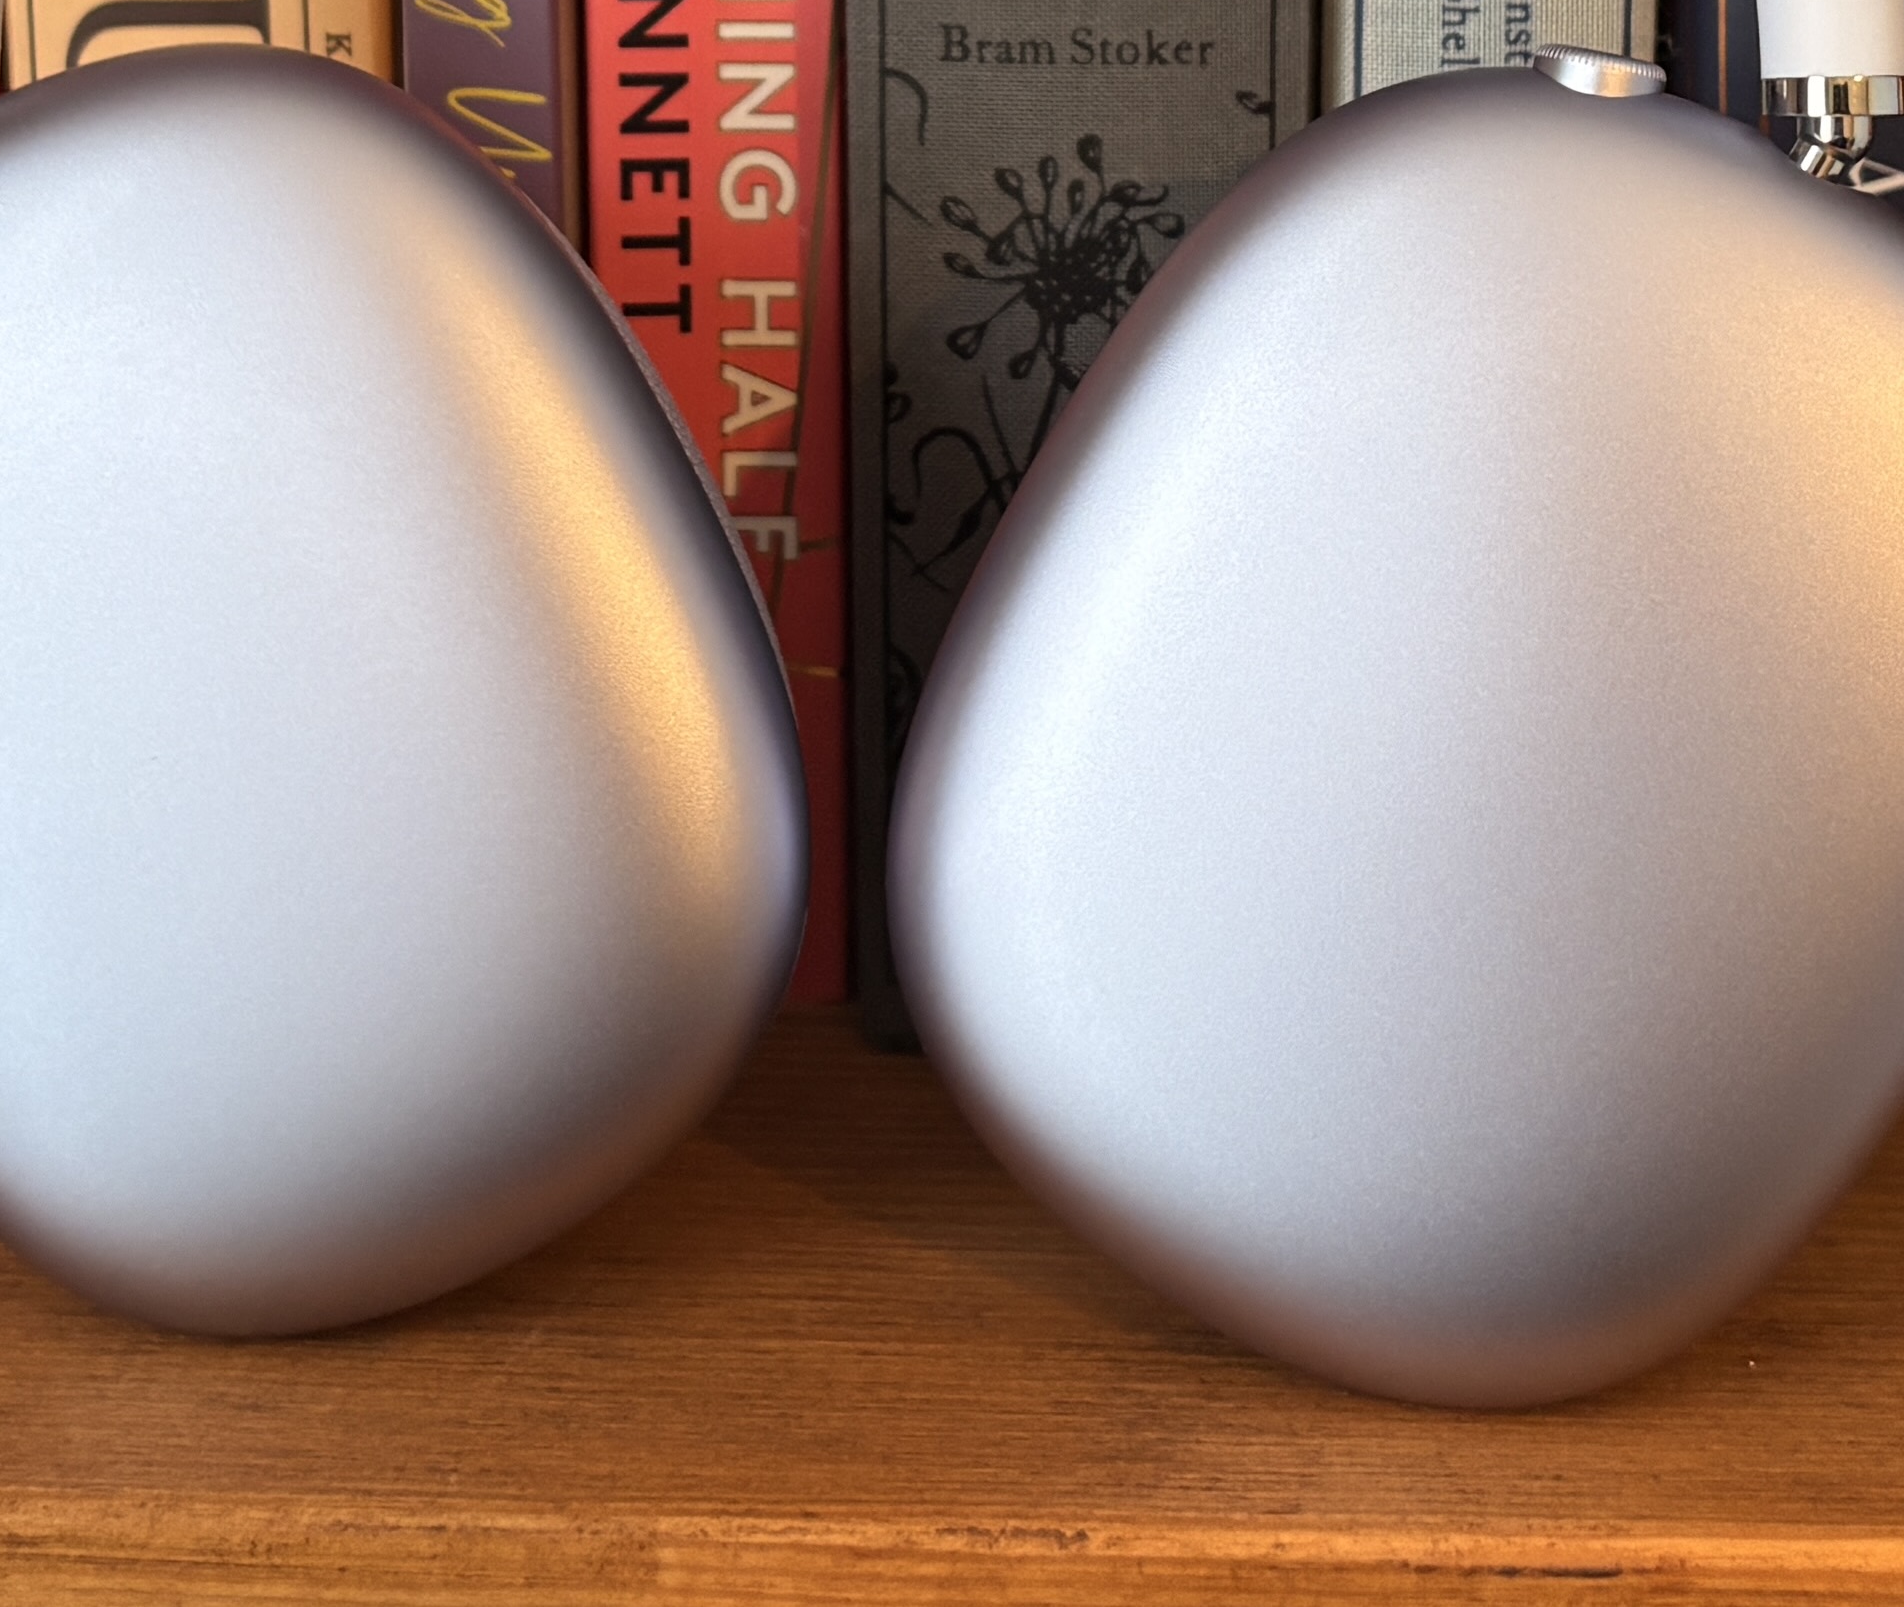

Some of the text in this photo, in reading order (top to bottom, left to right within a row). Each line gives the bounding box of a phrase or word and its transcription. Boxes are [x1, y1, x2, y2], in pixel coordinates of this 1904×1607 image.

[939, 23, 1216, 69] Bram Stoker
[720, 278, 799, 562] HALF
